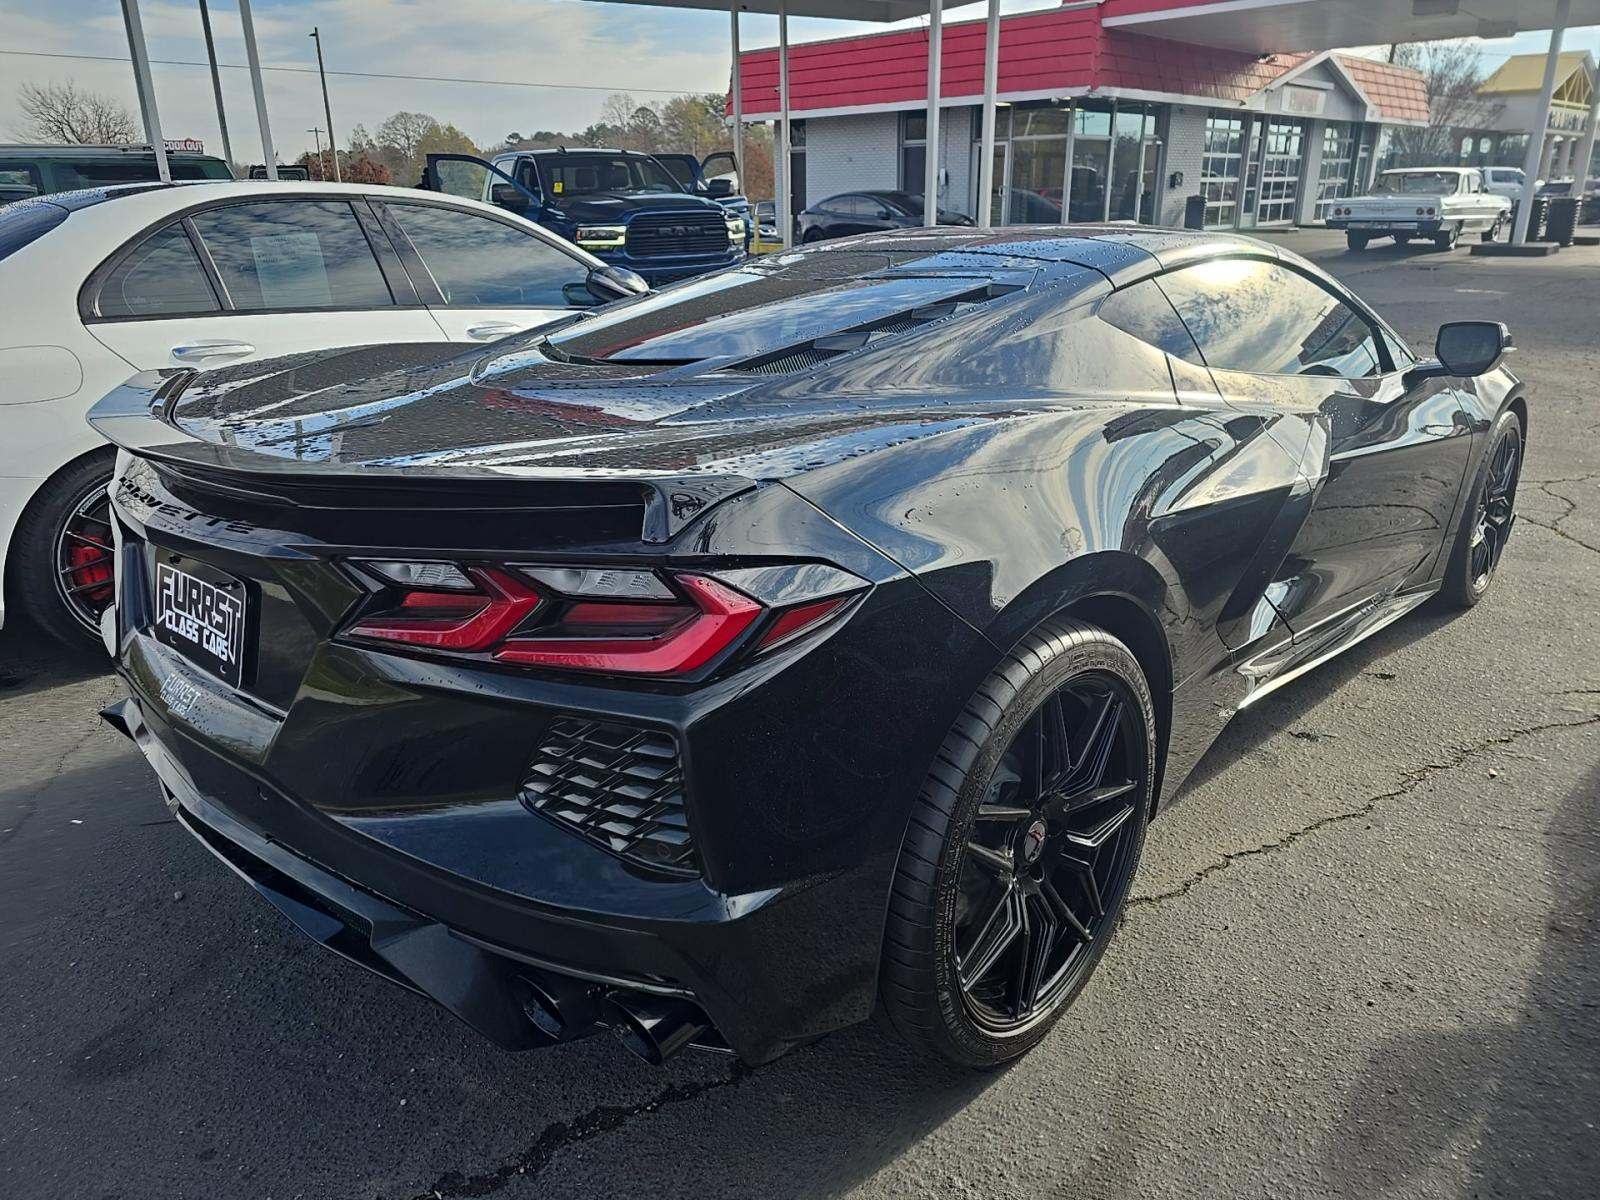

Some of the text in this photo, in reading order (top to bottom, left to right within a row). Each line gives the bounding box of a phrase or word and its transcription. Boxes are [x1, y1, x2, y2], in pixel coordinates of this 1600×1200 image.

[658, 226, 701, 237] RAM
[157, 562, 241, 665] FURRST
[165, 609, 229, 662] CLASS CARS
